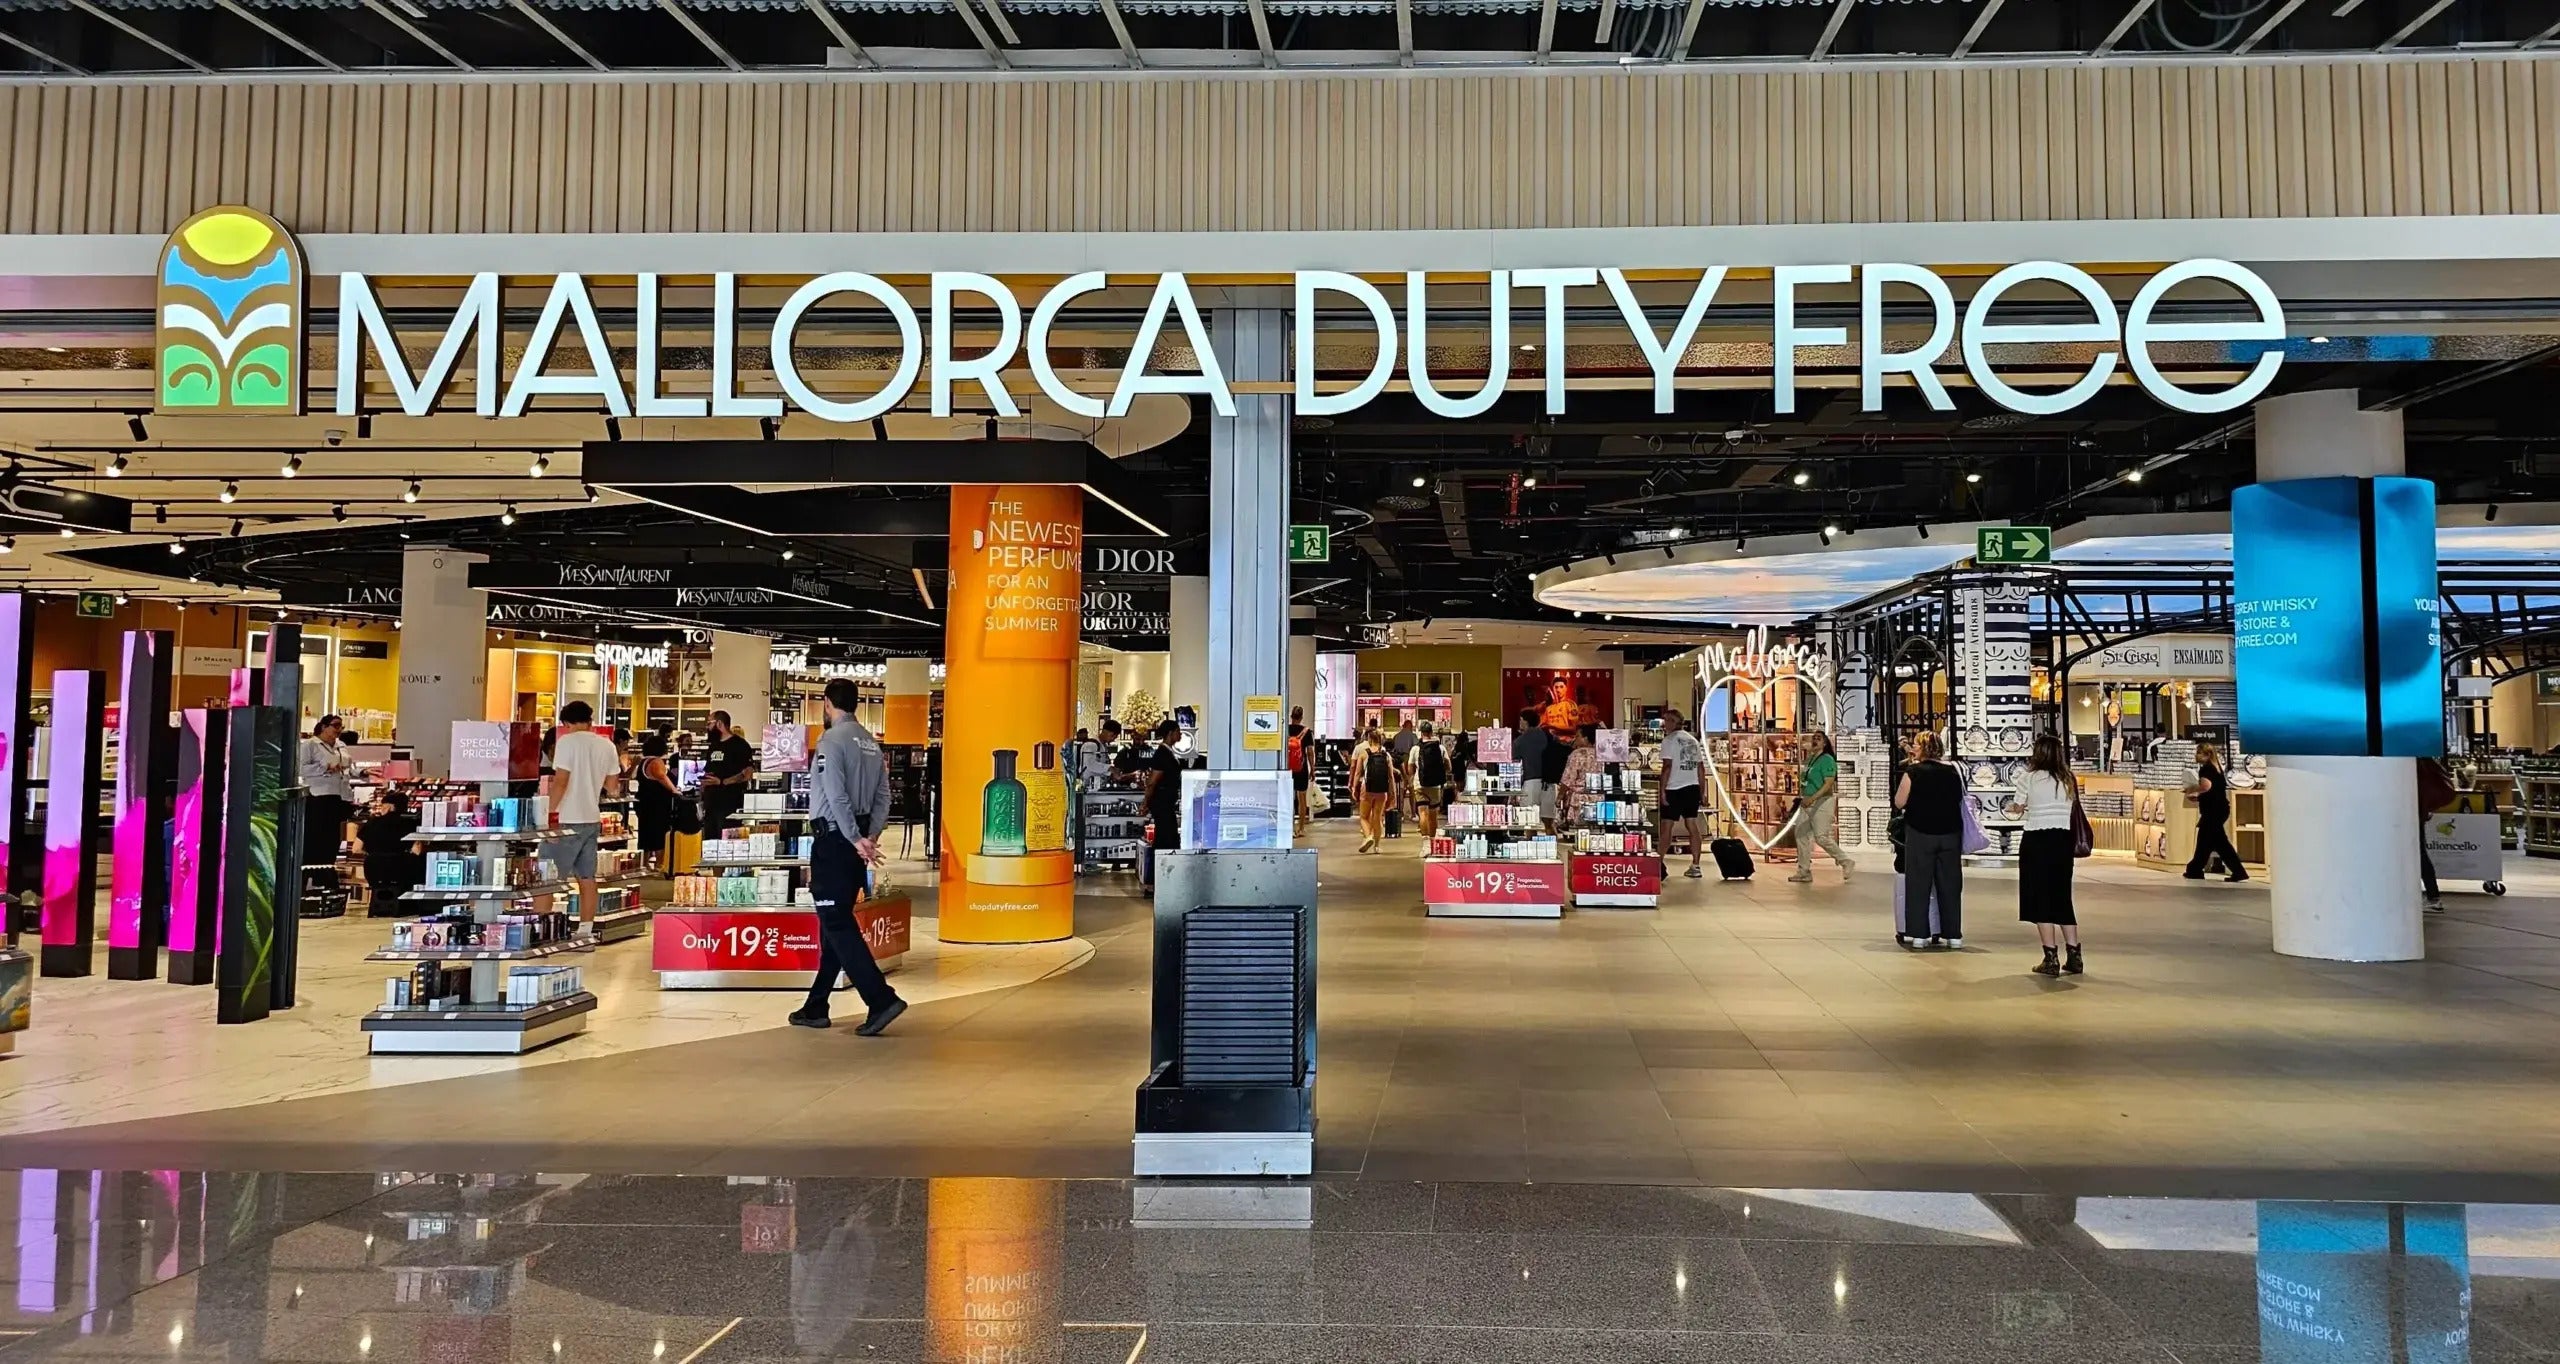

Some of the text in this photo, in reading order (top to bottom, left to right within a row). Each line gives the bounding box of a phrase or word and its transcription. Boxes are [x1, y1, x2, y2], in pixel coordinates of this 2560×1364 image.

[336, 271, 1239, 422] MALLORCA
[1295, 265, 1726, 418] DUTY
[989, 501, 1023, 515] THE
[989, 520, 1080, 547] NEWEST
[1096, 548, 1178, 573] DIOR
[987, 574, 1049, 590] FOR AN
[2261, 598, 2318, 611] WHISKY
[985, 616, 1058, 632] SUMMER
[1970, 598, 1979, 644] Artisans
[2281, 616, 2290, 627] &
[594, 643, 669, 668] SKINCARE
[1695, 624, 1832, 687] Mallorca
[820, 662, 874, 678] PLEASE
[1971, 650, 1979, 680] Local
[460, 738, 501, 748] SPECIAL
[462, 749, 498, 759] PRICES
[1592, 863, 1641, 875] SPECIAL
[1447, 877, 1473, 888] Solo
[1596, 876, 1638, 887] PRICES
[969, 902, 1039, 912] shopdutyfree.com
[682, 933, 720, 953] Only
